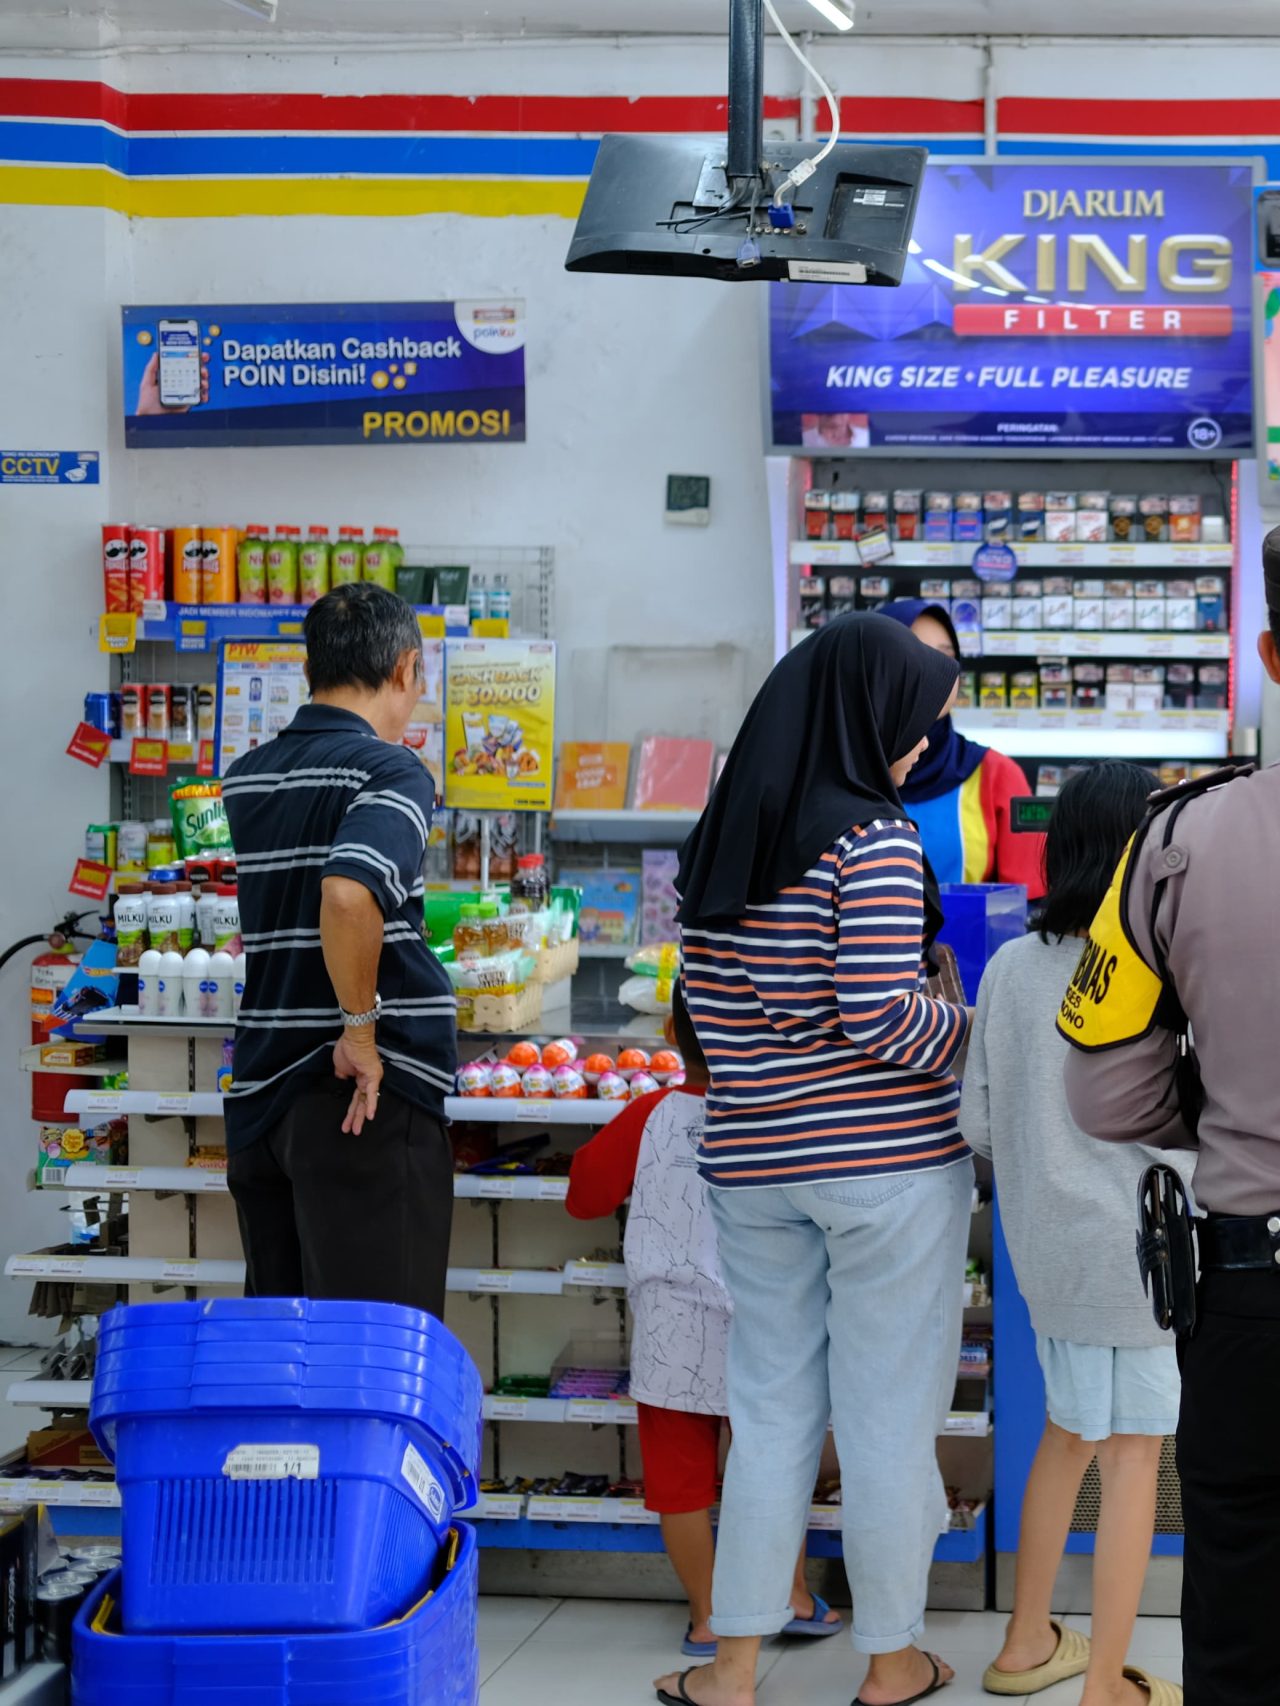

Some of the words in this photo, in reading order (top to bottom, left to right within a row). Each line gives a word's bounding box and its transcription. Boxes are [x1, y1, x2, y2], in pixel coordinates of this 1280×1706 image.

[1023, 188, 1164, 219] DJARUM
[952, 232, 1234, 293] KING
[1003, 308, 1182, 330] FILTER
[222, 337, 337, 366] Dapatkan
[341, 335, 463, 361] Cashback
[223, 364, 286, 387] POIN
[291, 363, 367, 386] Disini!
[825, 365, 893, 389] KING
[900, 366, 959, 389] SIZE
[977, 366, 1045, 389] FULL
[1050, 366, 1192, 389] PLEASURE
[363, 409, 511, 438] PROMOSI
[1, 457, 60, 476] CCTV
[117, 912, 145, 924] MILKU
